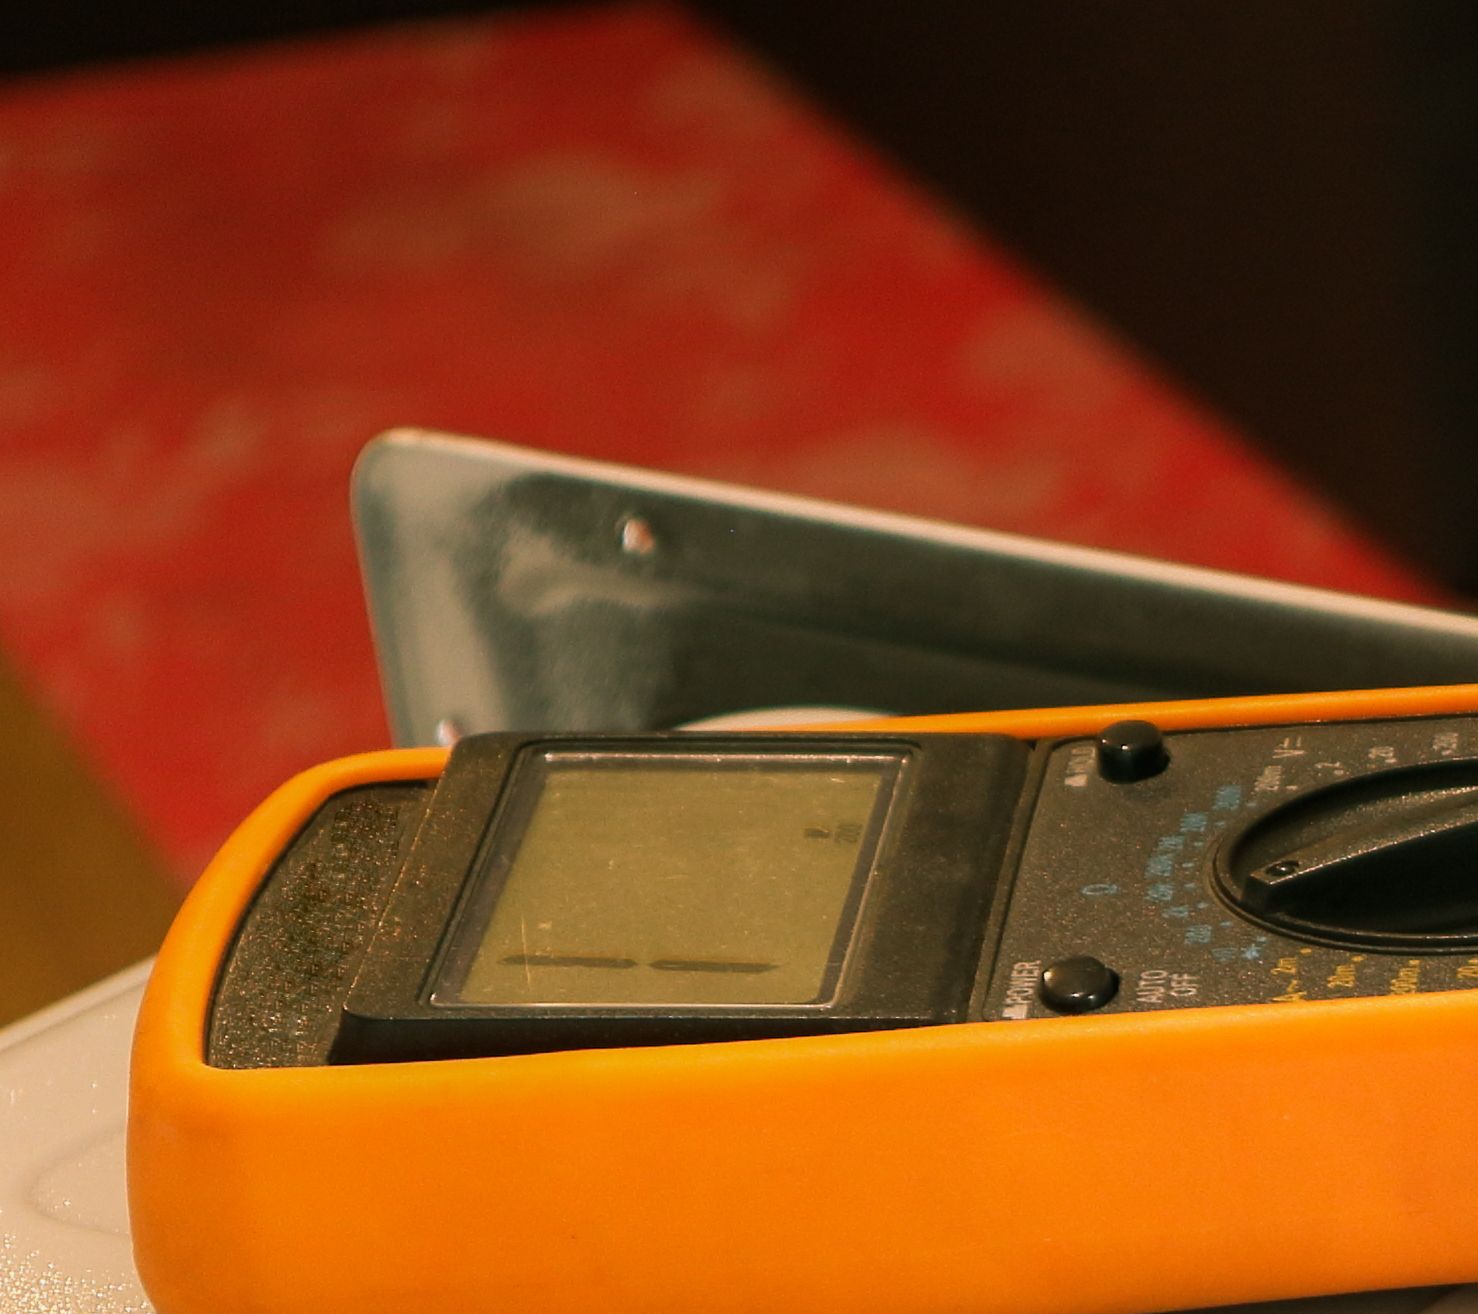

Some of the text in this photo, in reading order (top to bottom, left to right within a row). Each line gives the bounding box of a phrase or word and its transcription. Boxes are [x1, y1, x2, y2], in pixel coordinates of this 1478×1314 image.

[1006, 959, 1041, 1004] POWER
[1136, 970, 1168, 1004] AUTO
[1170, 972, 1199, 997] OFF
